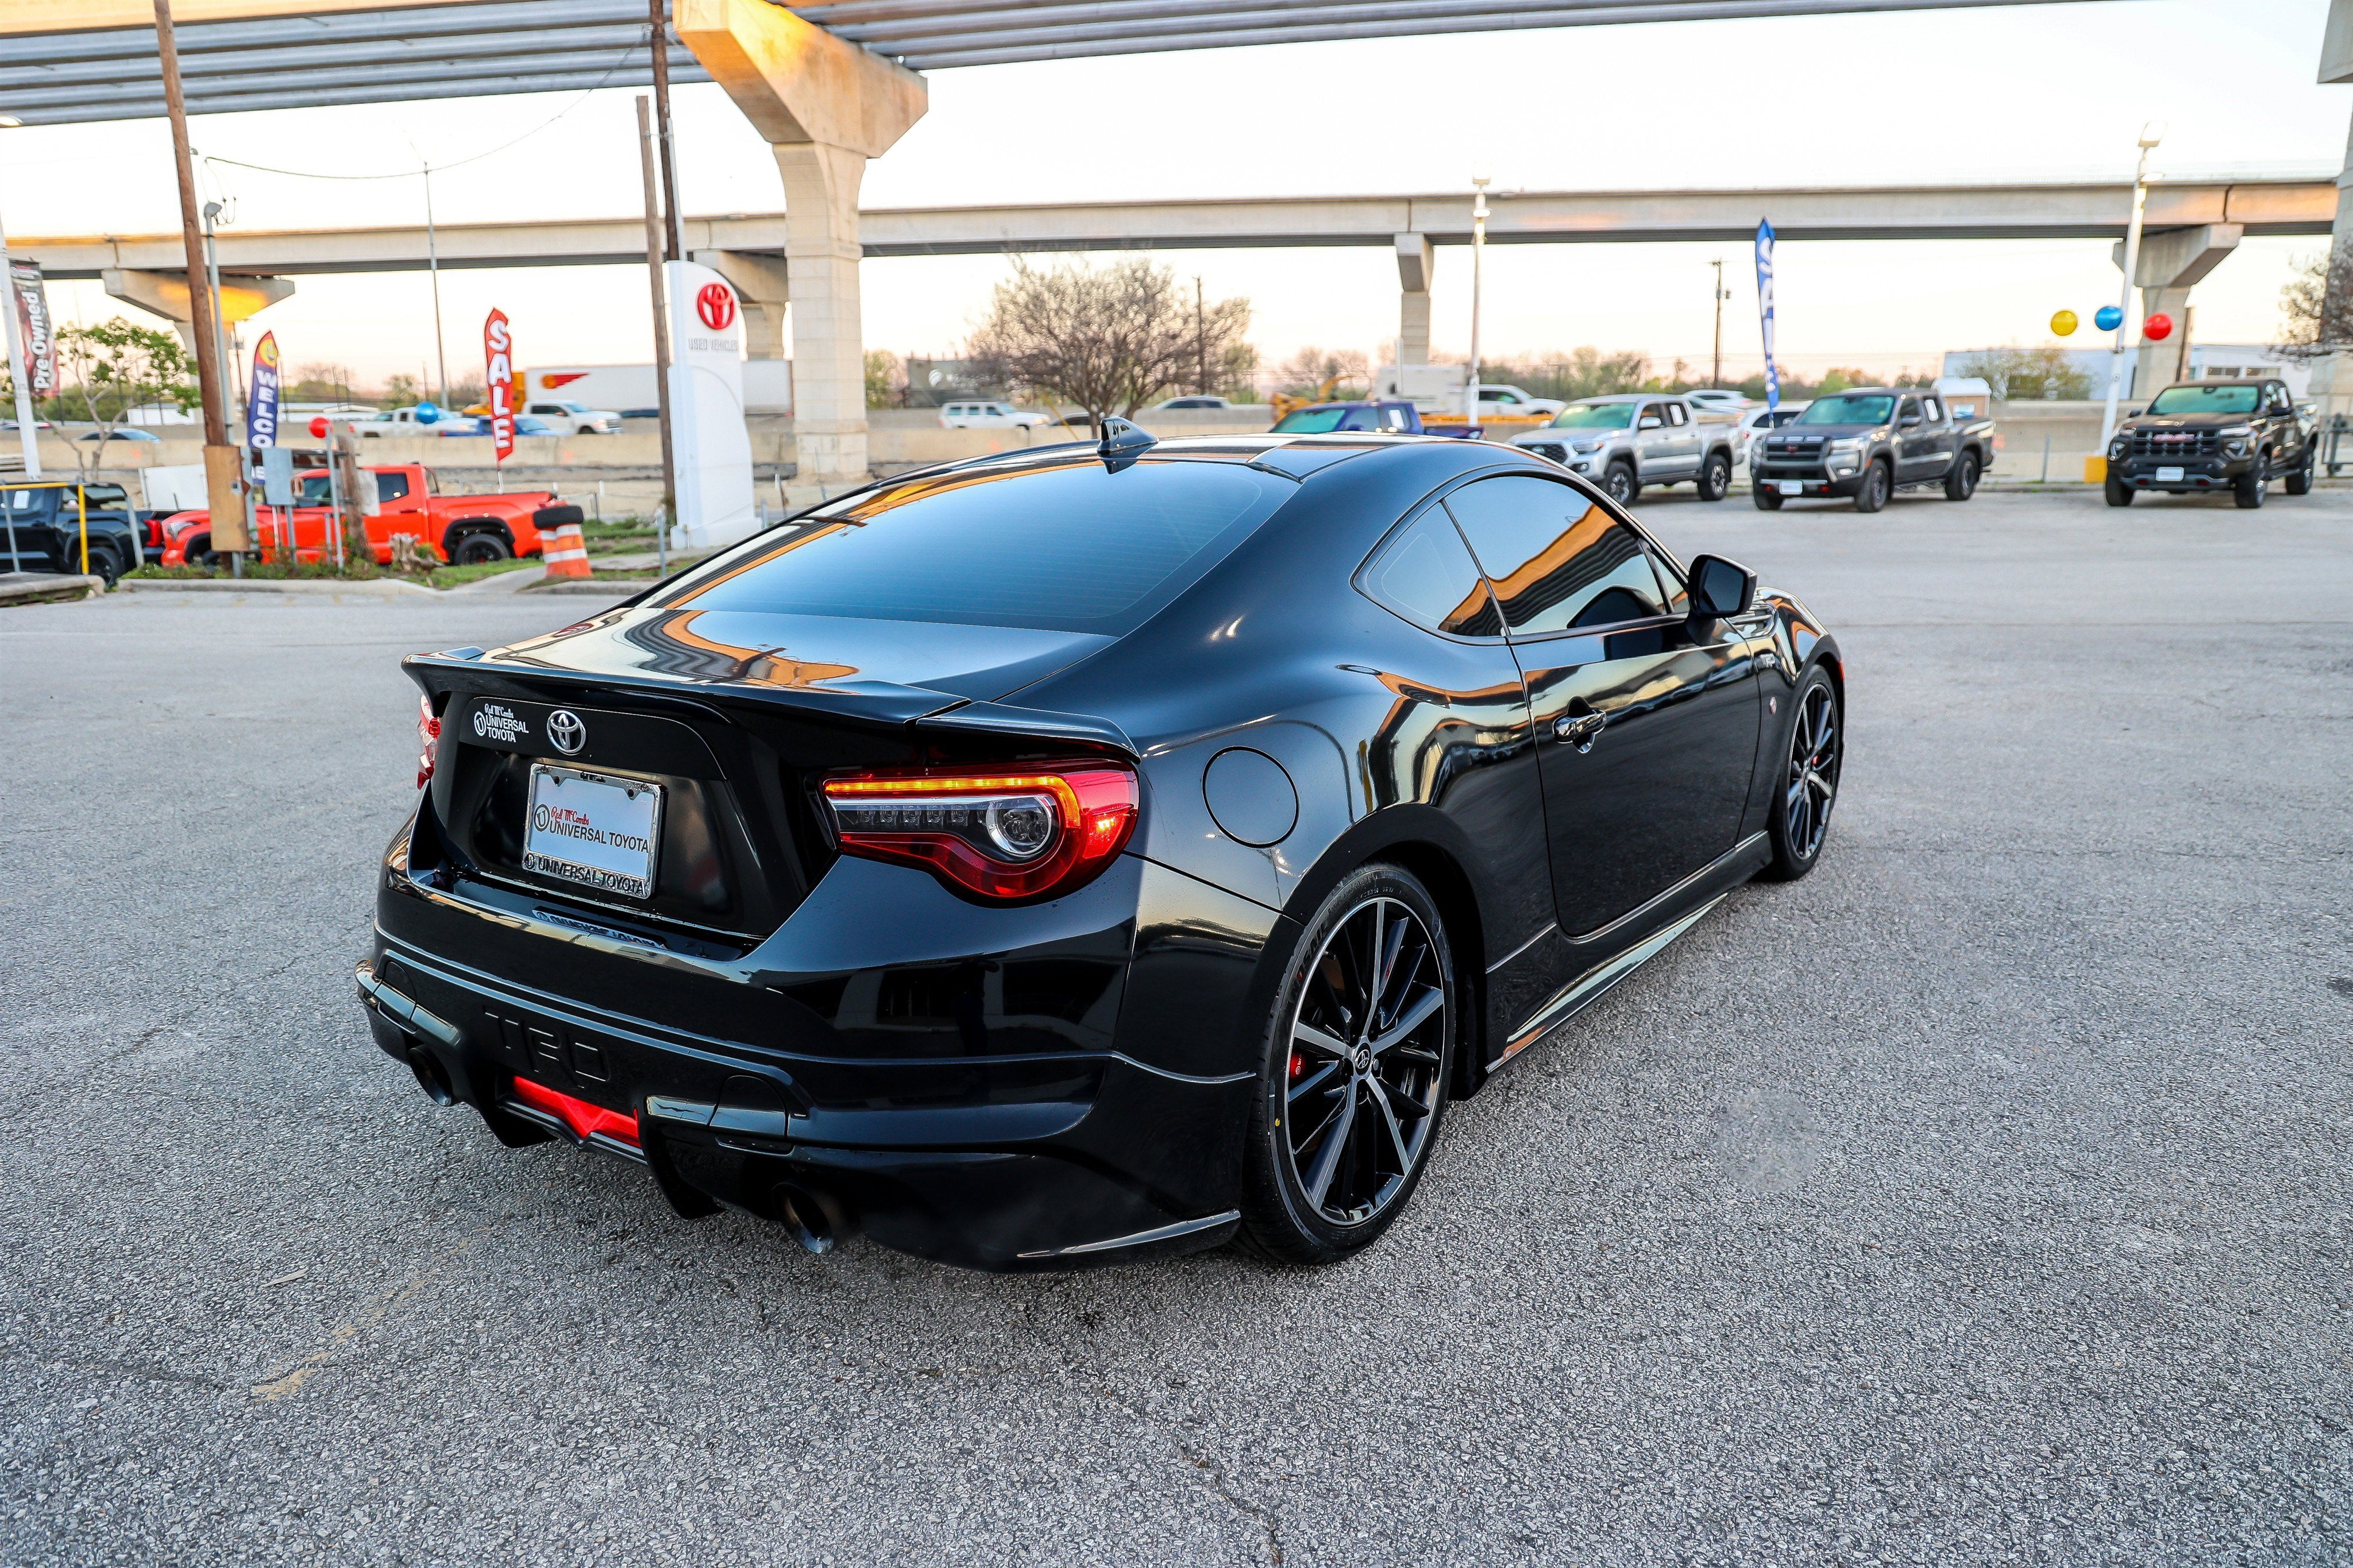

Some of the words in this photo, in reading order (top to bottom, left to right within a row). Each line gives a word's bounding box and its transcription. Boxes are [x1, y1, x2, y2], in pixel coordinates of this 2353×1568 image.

[21, 291, 47, 356] Owned
[33, 357, 50, 389] Pre
[488, 319, 512, 449] SALE
[251, 369, 277, 480] WELCOE
[485, 715, 529, 733] UNIVERSAL
[487, 727, 516, 743] TOYOTA
[551, 806, 563, 824] Red
[564, 809, 589, 826] McCombs
[549, 820, 607, 844] UNIVERSAL
[609, 832, 649, 853] TOYOTA
[538, 856, 599, 885] UNIVERSAL
[600, 871, 645, 895] TOYOTA
[483, 1006, 611, 1089] TRD
